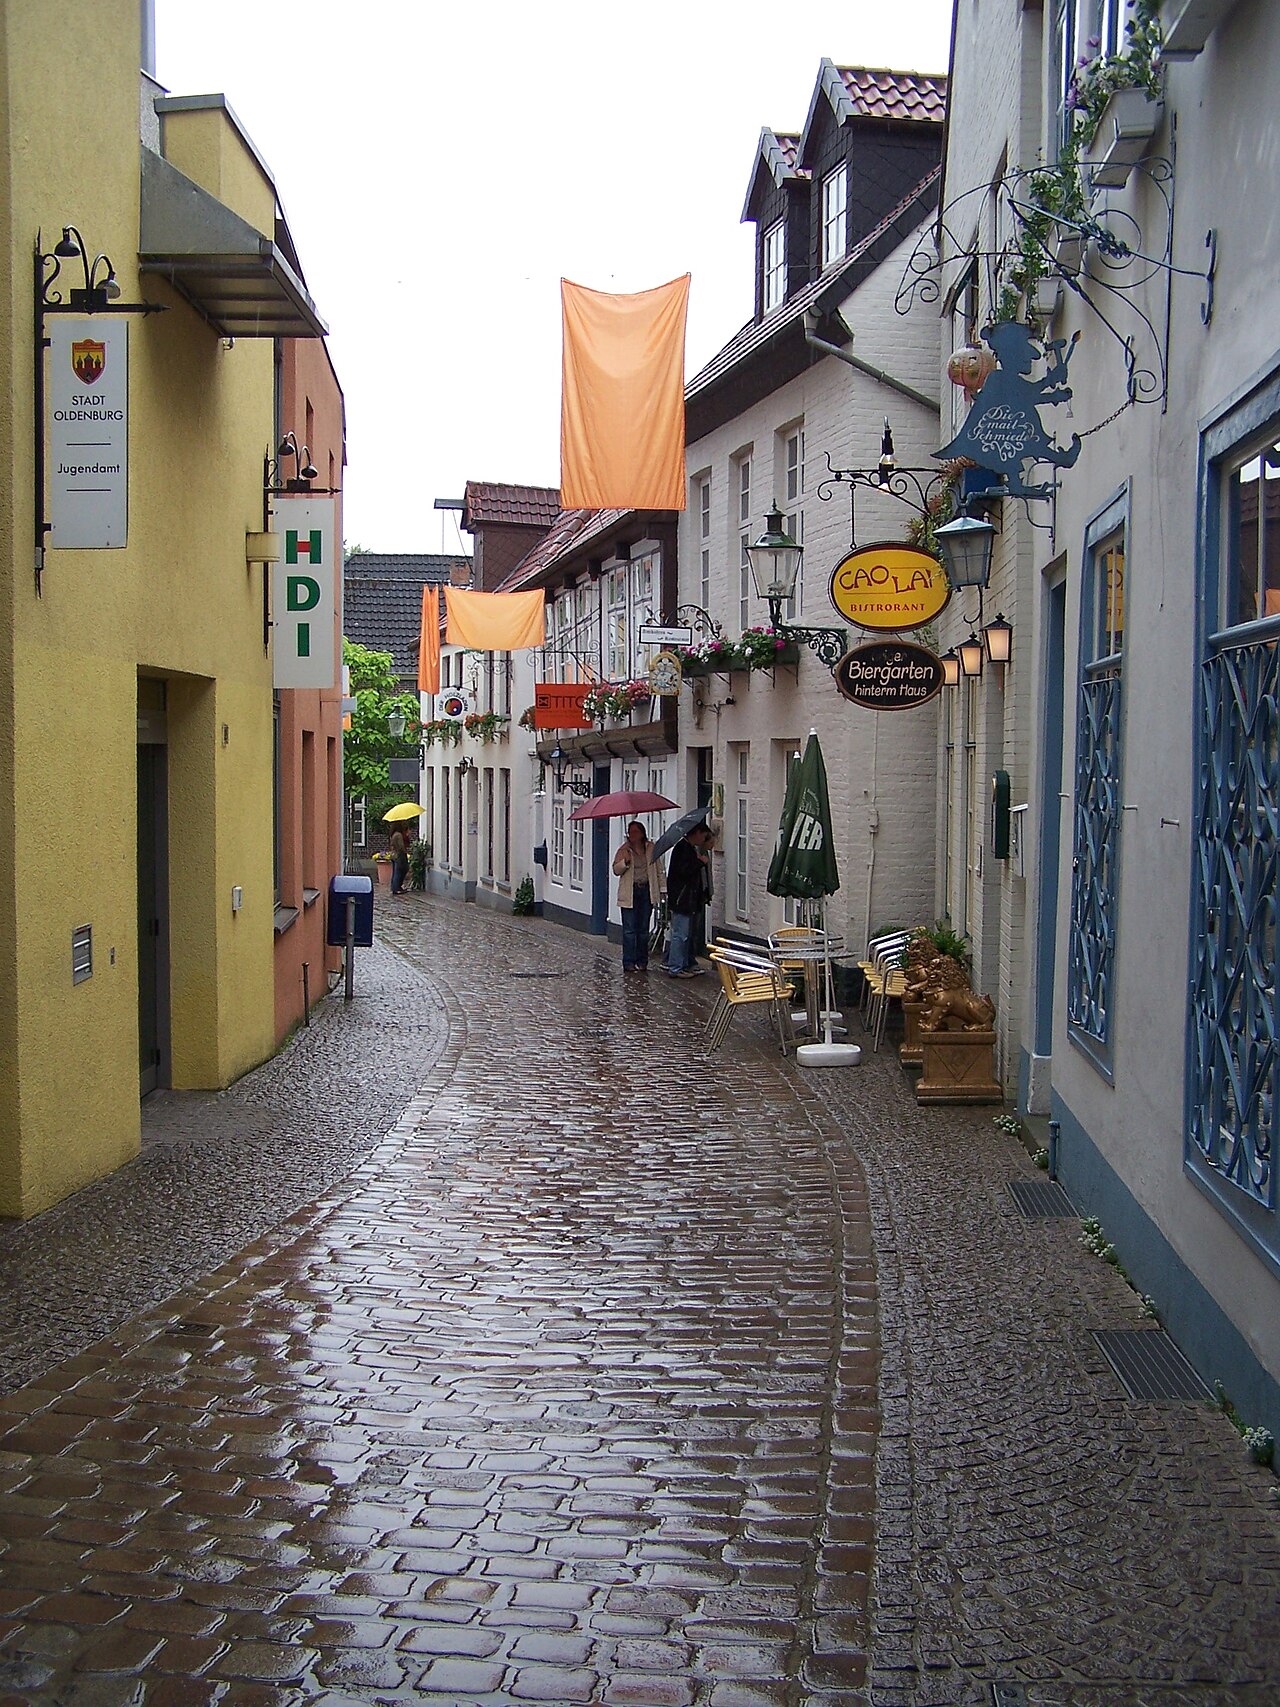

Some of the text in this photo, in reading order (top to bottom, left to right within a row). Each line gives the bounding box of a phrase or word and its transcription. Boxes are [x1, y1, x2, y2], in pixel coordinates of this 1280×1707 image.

[71, 395, 106, 406] STADT
[53, 410, 124, 421] OLDENBURG
[987, 404, 1025, 420] Die
[57, 463, 121, 476] Jugendamt
[839, 565, 933, 594] CAO LAI
[285, 530, 322, 657] HDI
[850, 603, 925, 612] BISTRORANT
[848, 660, 934, 685] Biergarten
[855, 684, 927, 697] hinterm Haus
